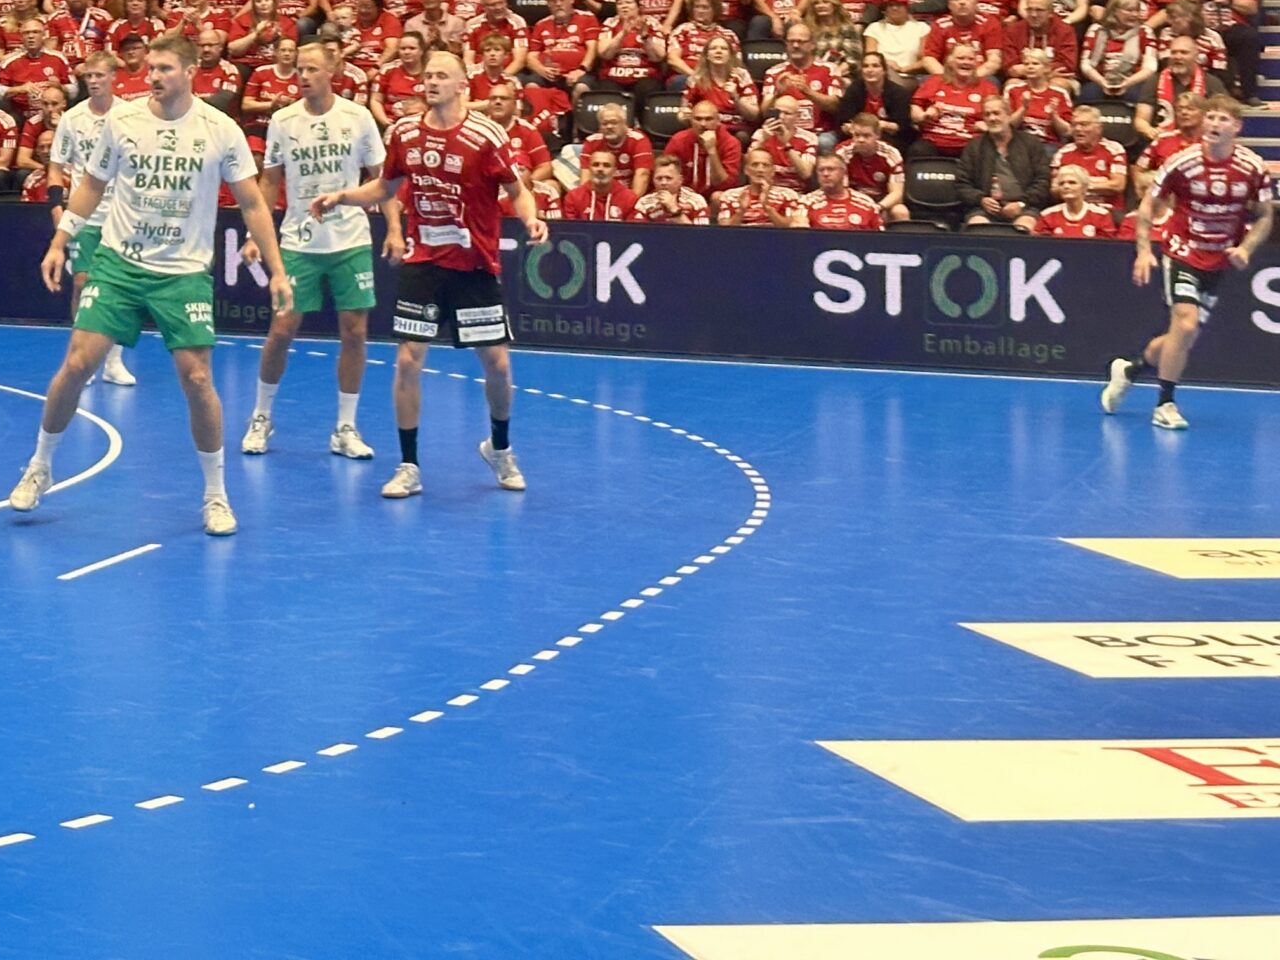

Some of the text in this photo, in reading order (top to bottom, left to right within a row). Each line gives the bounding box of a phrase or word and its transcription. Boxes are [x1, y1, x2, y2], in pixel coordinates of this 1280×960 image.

[291, 143, 352, 161] SKJERN
[129, 154, 204, 173] SKJERN
[300, 160, 343, 176] BANK
[135, 173, 192, 190] BANK
[917, 172, 955, 180] renom
[812, 249, 1067, 324] STOK
[520, 314, 647, 339] Emballage
[923, 333, 1066, 364] Emballage
